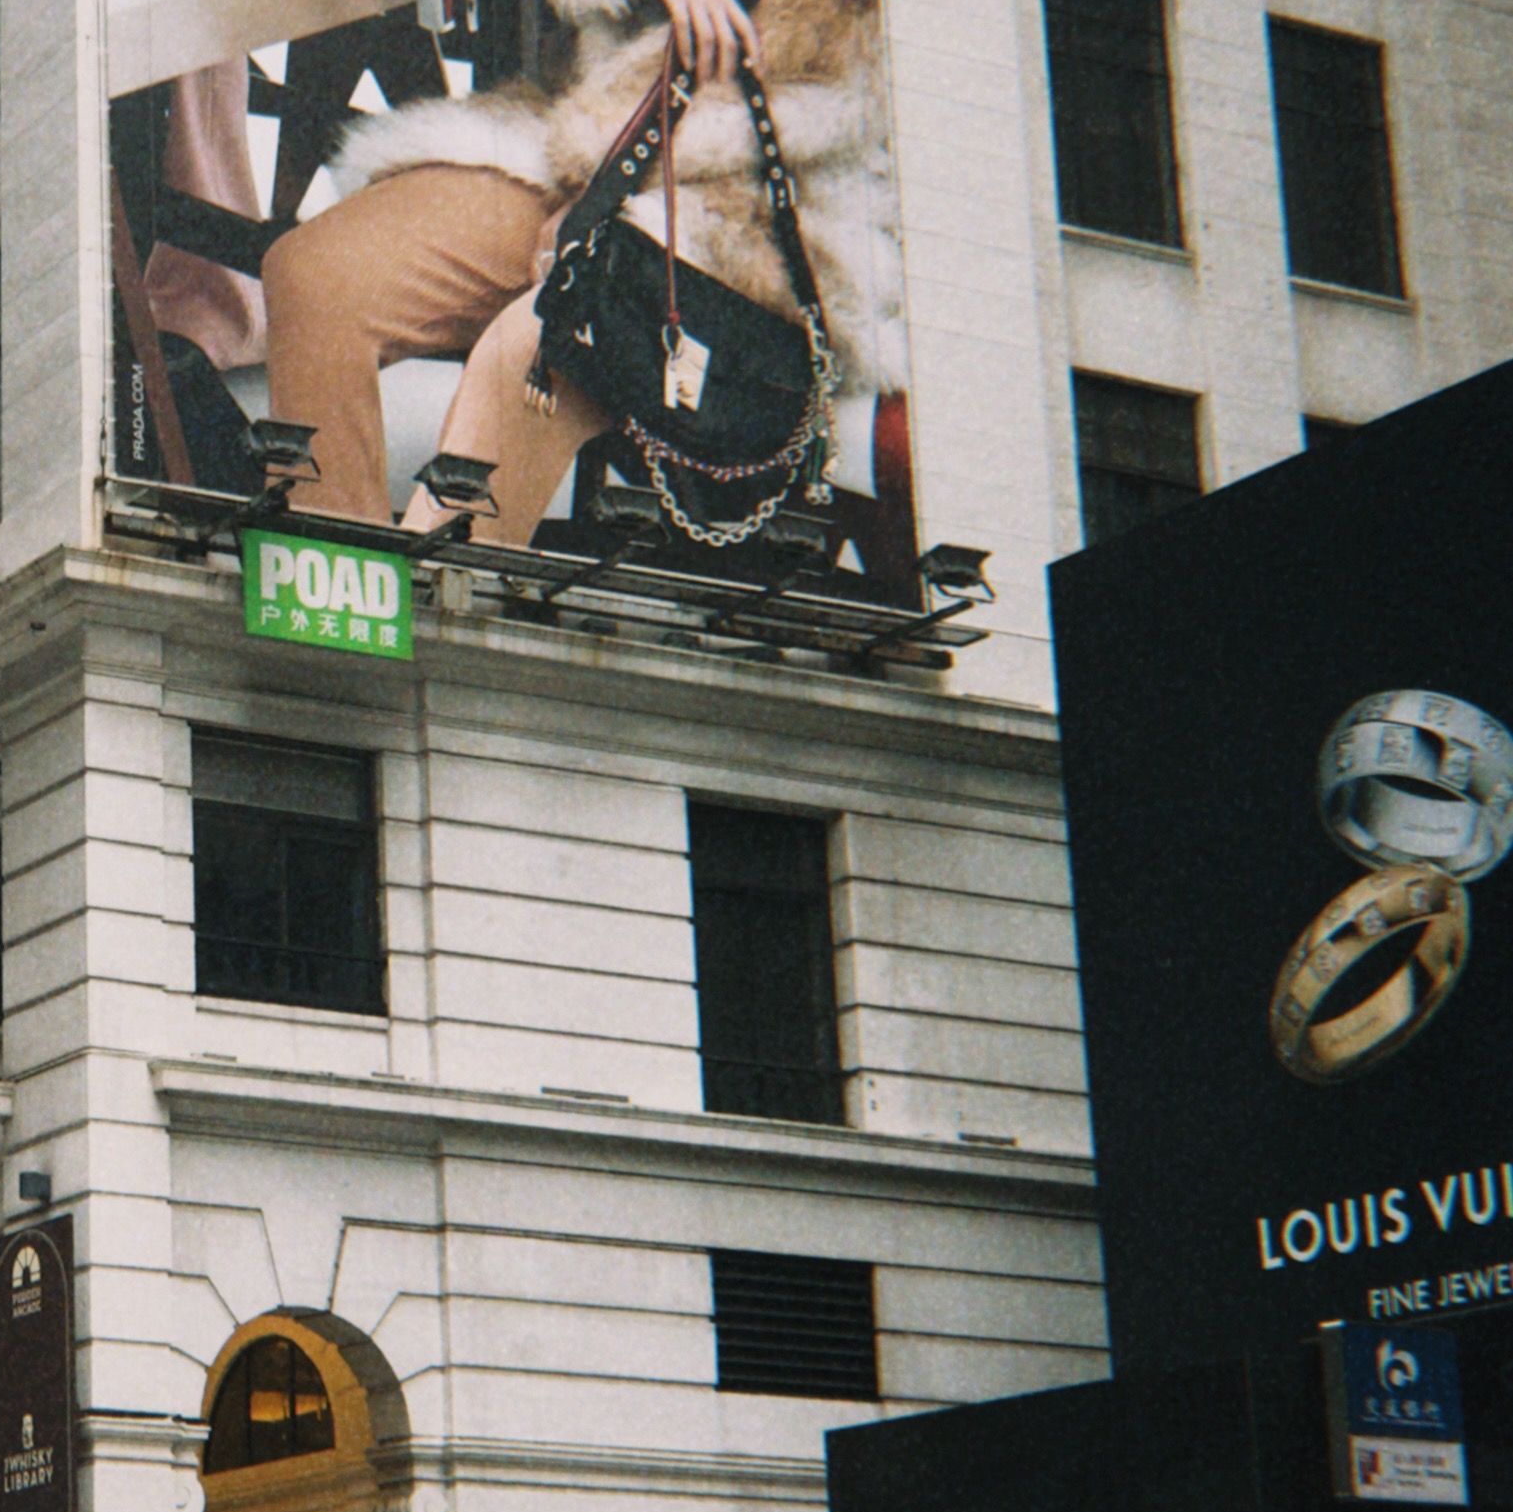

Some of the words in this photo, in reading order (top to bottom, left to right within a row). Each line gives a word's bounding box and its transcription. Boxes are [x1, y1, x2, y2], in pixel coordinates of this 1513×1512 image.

[131, 363, 145, 462] PRADA.COM
[260, 542, 400, 620] POAD
[1256, 1187, 1412, 1270] LOUIS
[1367, 1279, 1431, 1319] FINE
[1437, 1261, 1513, 1307] JEWE
[3, 1464, 55, 1493] LIBRARY
